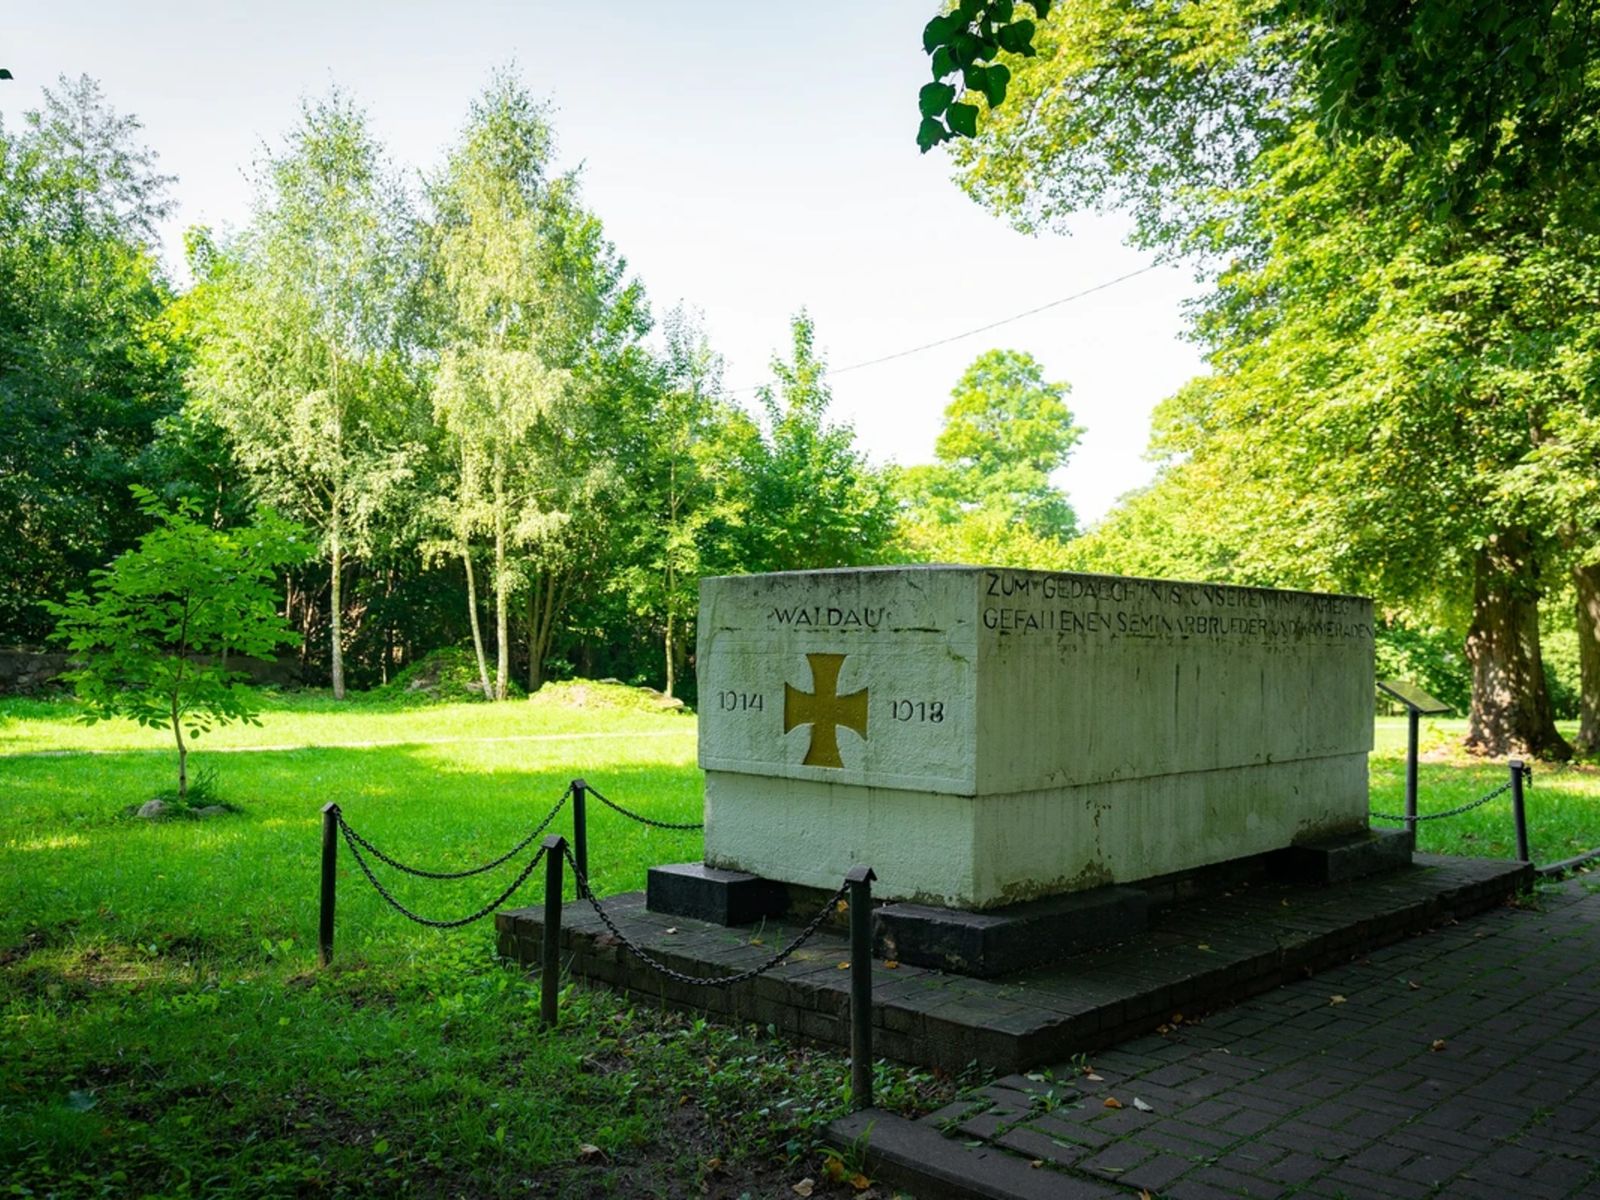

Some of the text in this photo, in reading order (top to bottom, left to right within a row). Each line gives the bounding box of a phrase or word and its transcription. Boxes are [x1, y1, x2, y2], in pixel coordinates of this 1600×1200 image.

[986, 572, 1030, 597] ZUM
[774, 606, 885, 628] WALDAU
[718, 691, 764, 712] 1914
[891, 699, 944, 723] 1918
